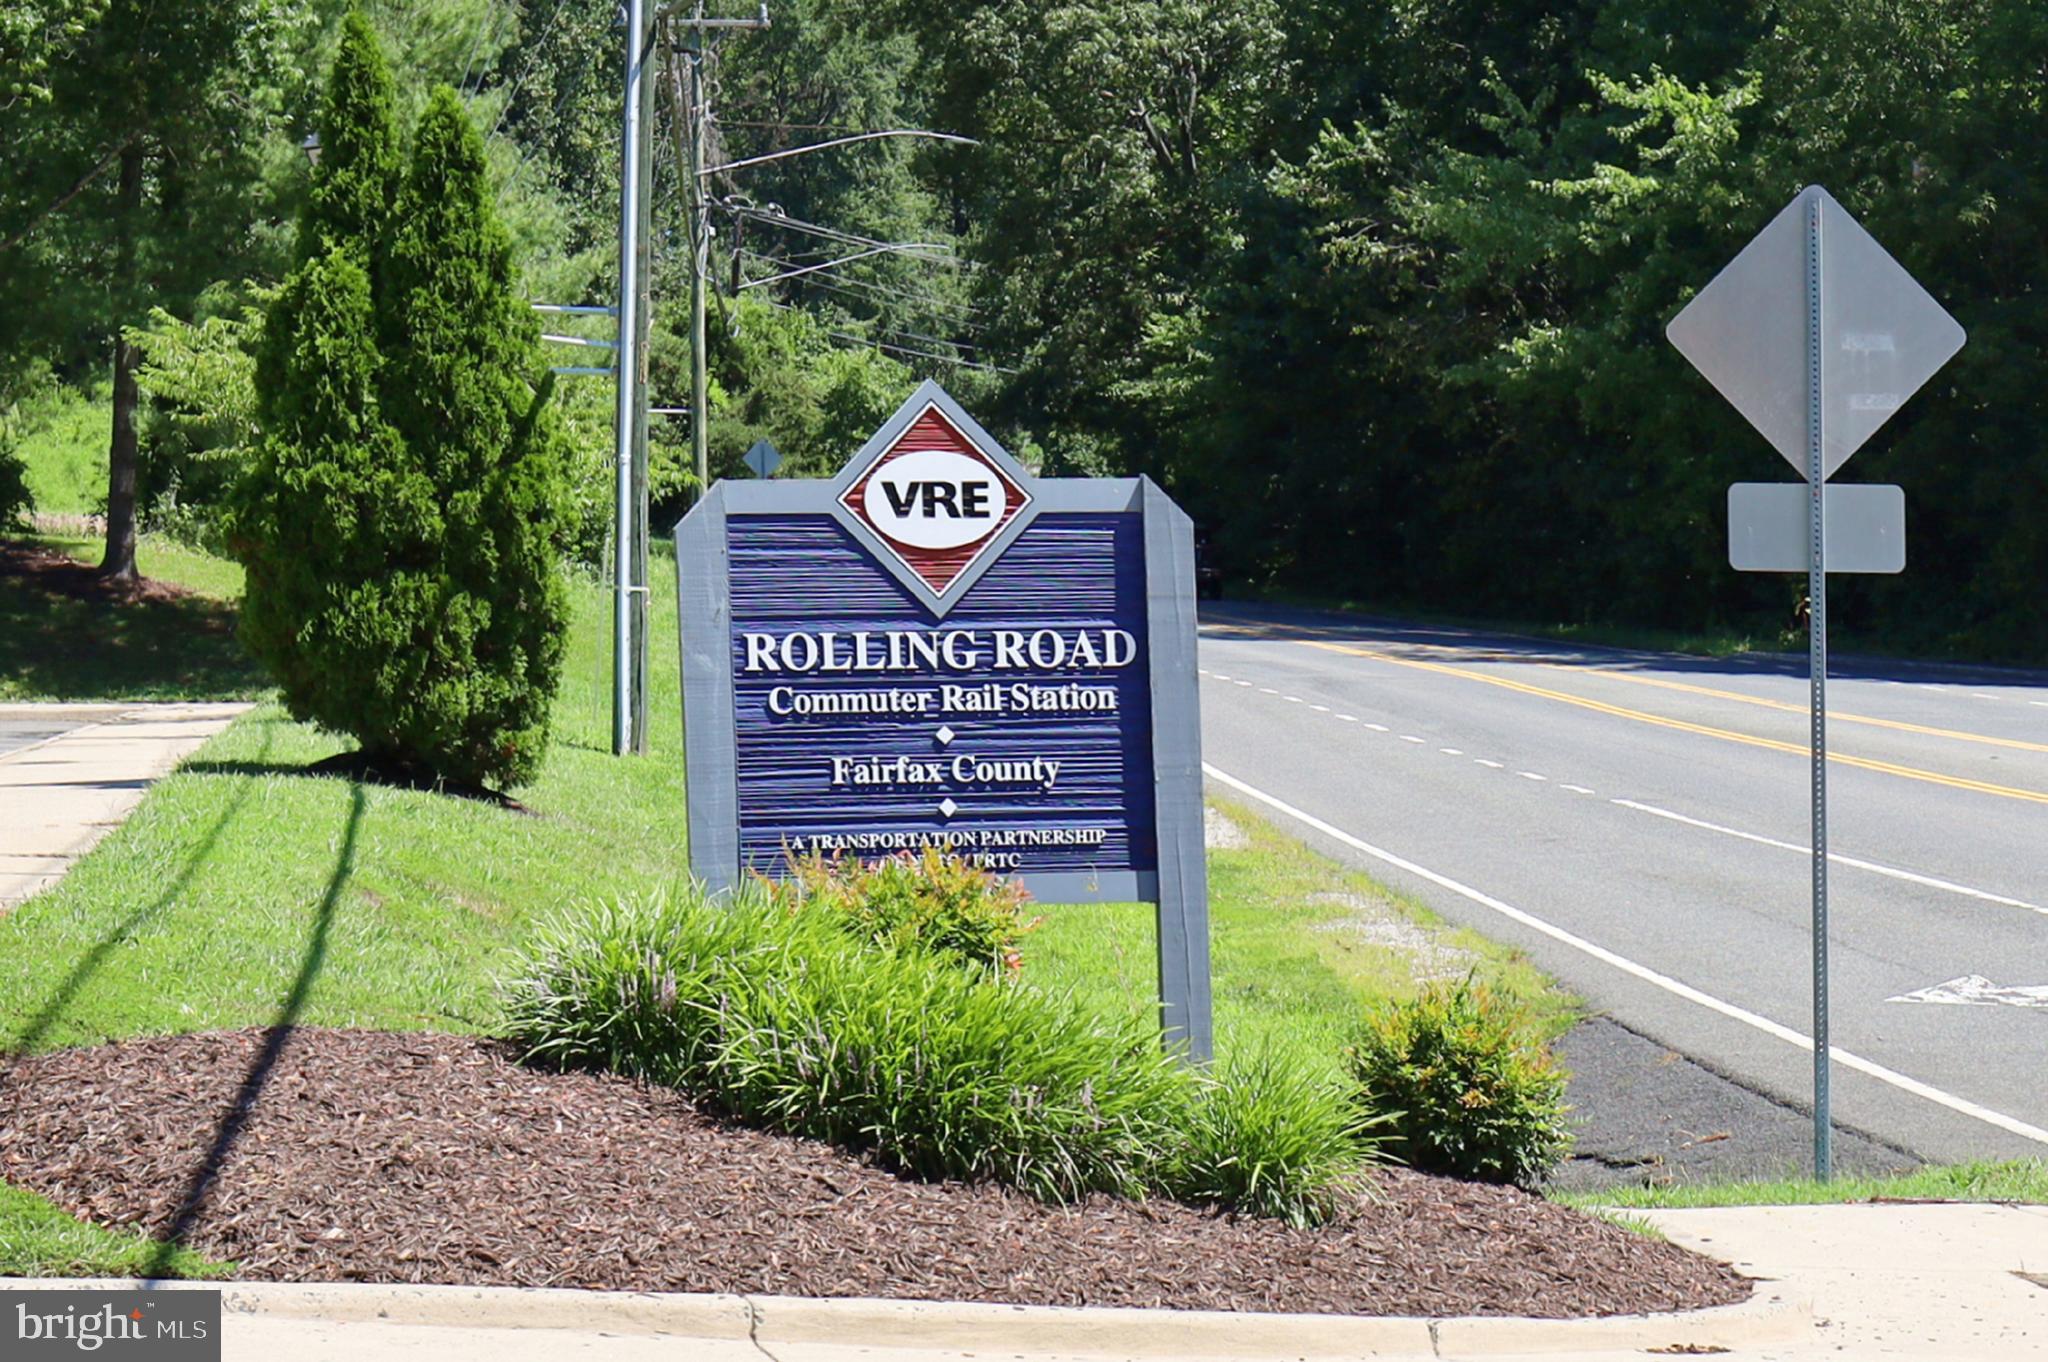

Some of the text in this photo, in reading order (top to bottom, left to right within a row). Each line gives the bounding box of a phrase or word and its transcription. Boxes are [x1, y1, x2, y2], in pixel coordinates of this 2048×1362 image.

[882, 481, 990, 519] VRE
[743, 629, 1137, 671] ROLLING ROAD
[768, 682, 1117, 714] Commuter Rail Station
[831, 755, 1060, 787] Fairfax County
[792, 829, 1107, 849] A TRANSPORTATION PARTNERSHIP
